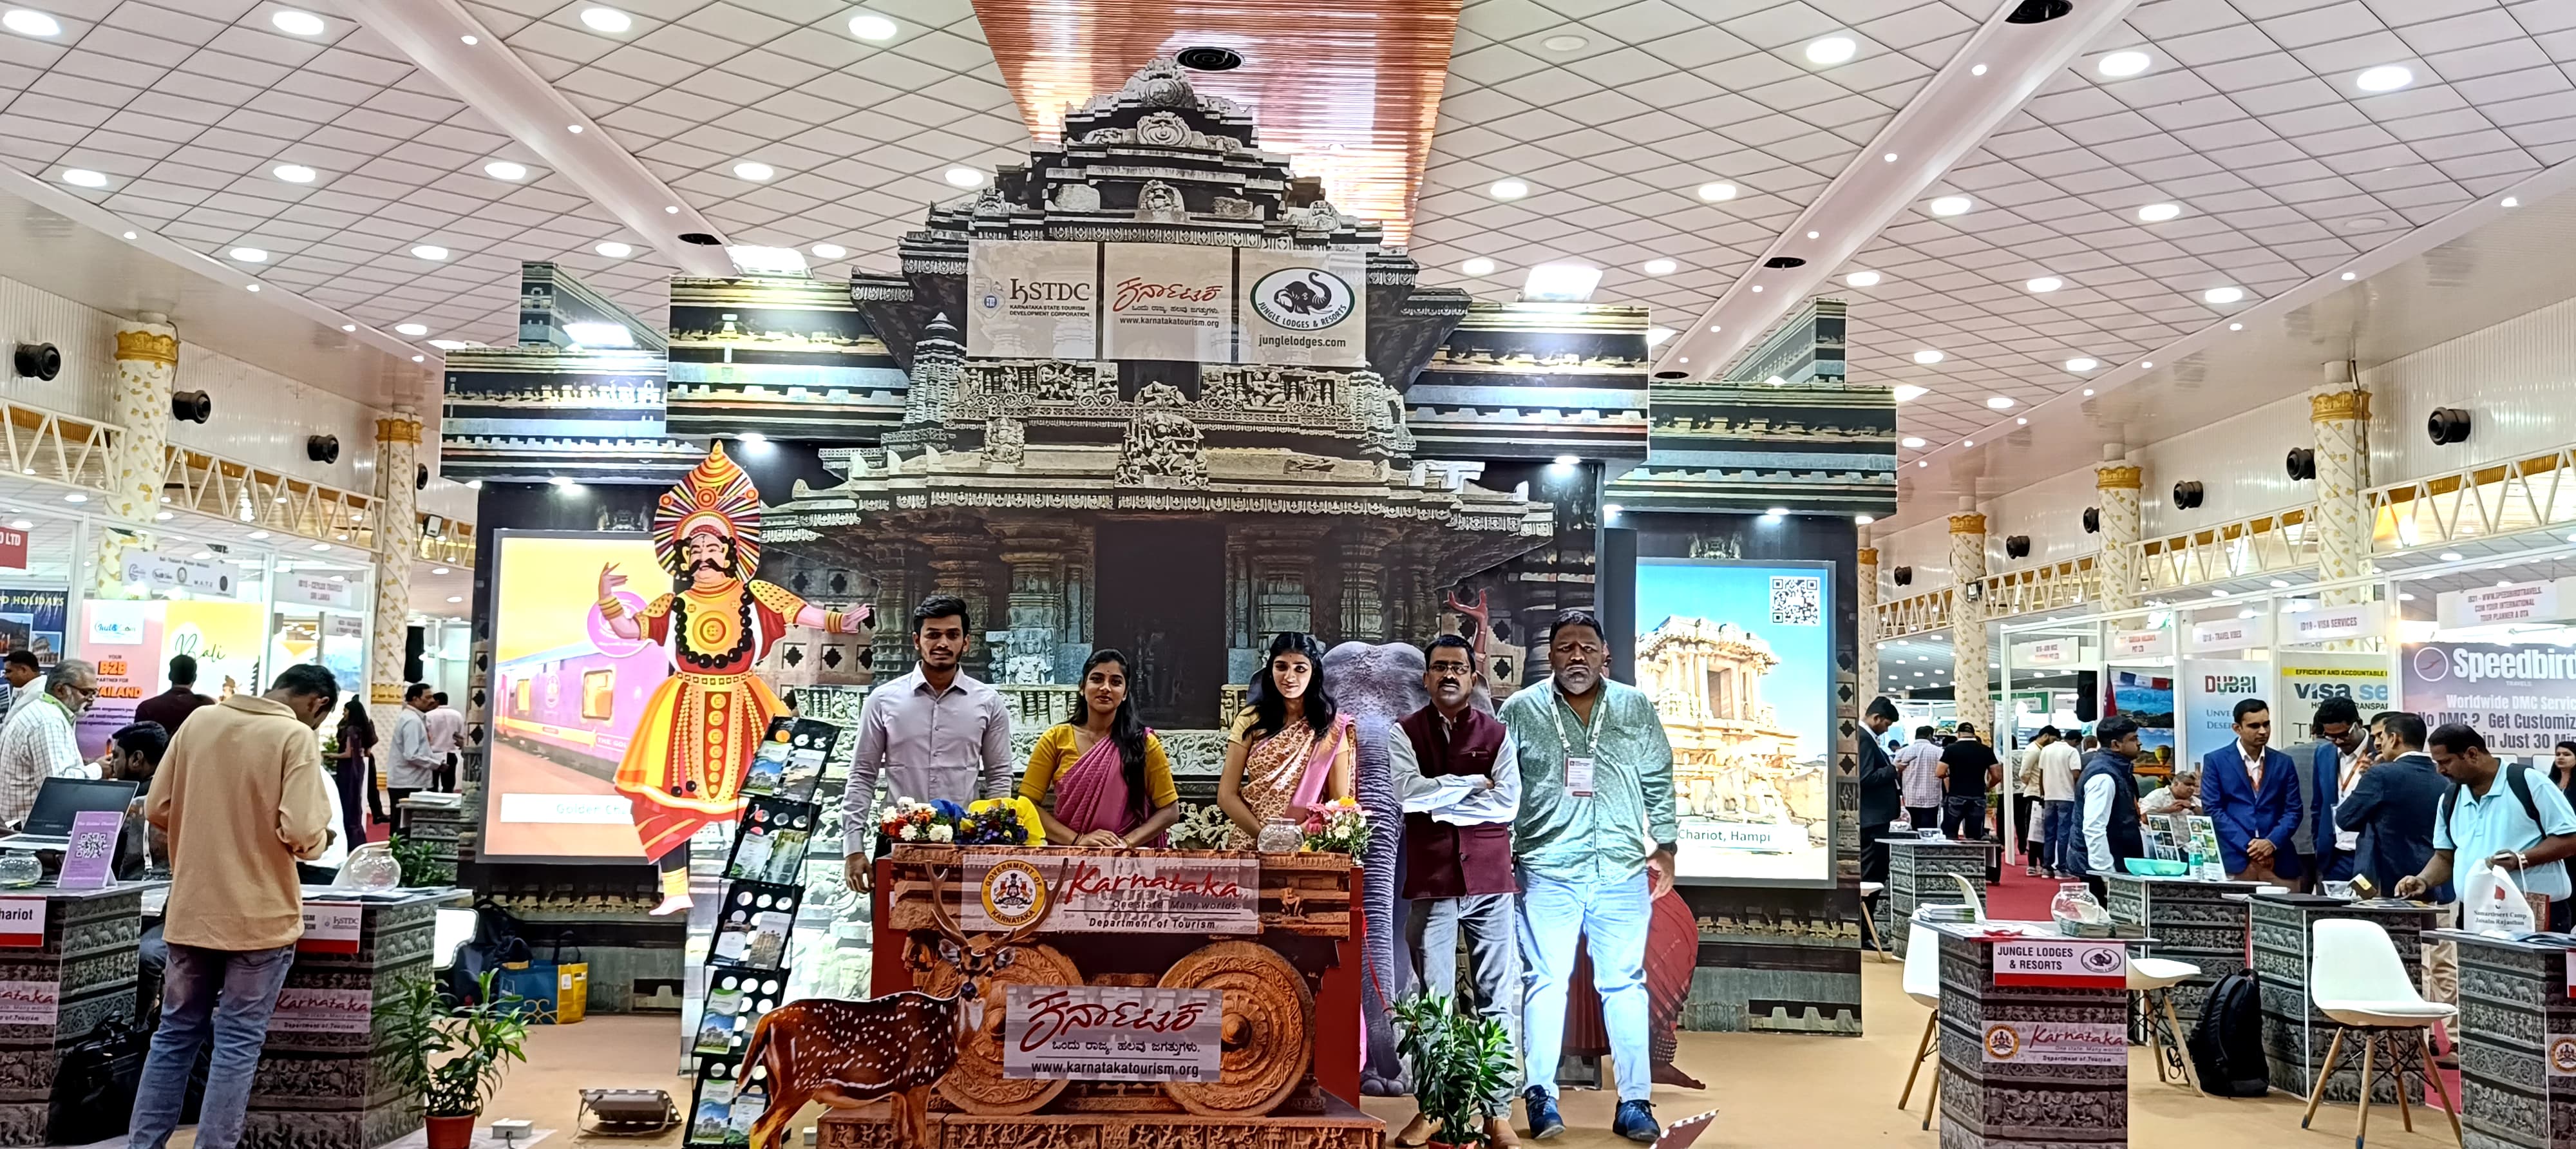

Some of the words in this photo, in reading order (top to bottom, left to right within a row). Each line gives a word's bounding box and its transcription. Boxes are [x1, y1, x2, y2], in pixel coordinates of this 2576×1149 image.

[1113, 277, 1223, 312] ಕರ್ನಾಟಕ
[1120, 317, 1220, 328] www.karnatakatourism.org
[1258, 302, 1280, 323] JUNGLE
[1282, 318, 1309, 328] LODGES
[1321, 304, 1347, 325] RESORTS
[1258, 334, 1346, 348] junglelodges.com
[6, 532, 21, 546] LTD
[13, 596, 64, 607] HOLIDAYS
[2499, 599, 2535, 609] INTERNATIONAL
[2494, 612, 2514, 620] PLANNER
[2300, 622, 2313, 631] ID19
[2318, 620, 2330, 629] VISA
[2331, 617, 2357, 629] SERVICES
[98, 661, 127, 675] B2B
[2205, 676, 2256, 693] DUBAI
[2294, 683, 2351, 699] visa
[97, 686, 142, 699] AILAND
[2446, 694, 2509, 708] Worldwide
[2512, 696, 2537, 709] DMC
[2439, 712, 2468, 725] DMC
[2472, 713, 2479, 727] ?
[2488, 714, 2510, 729] Get
[2515, 713, 2576, 730] Customiz
[2483, 732, 2495, 748] in
[2500, 732, 2530, 748] Just
[2533, 734, 2550, 748] 30
[1678, 830, 1726, 842] Chariot,
[1731, 831, 1770, 844] Hampi
[985, 862, 1034, 886] GOVERNMENT
[1034, 877, 1042, 886] OF
[1064, 860, 1239, 905] Karnataka
[1112, 900, 1133, 908] One
[1170, 901, 1198, 910] Many
[991, 909, 1035, 924] KARNATAKA
[1089, 918, 1152, 928] Department
[1157, 919, 1167, 927] of
[1172, 920, 1215, 929] Tourism
[1998, 947, 2033, 956] JUNGLE
[2036, 947, 2073, 957] LODGES
[2009, 960, 2016, 969] &
[2020, 960, 2062, 970] RESORTS
[0, 989, 53, 1004] ataka
[273, 991, 368, 1013] Karnataka
[1019, 991, 1207, 1052] ಕರ್ನಾಟಕ
[2029, 1024, 2124, 1048] Karnataka
[1052, 1041, 1080, 1050] ಒಂದು
[1117, 1041, 1146, 1052] ಹಲವು
[1151, 1042, 1200, 1056] ಜಗತ್ತುಗಳು.
[1032, 1061, 1198, 1078] www.karnatakatourism.org
